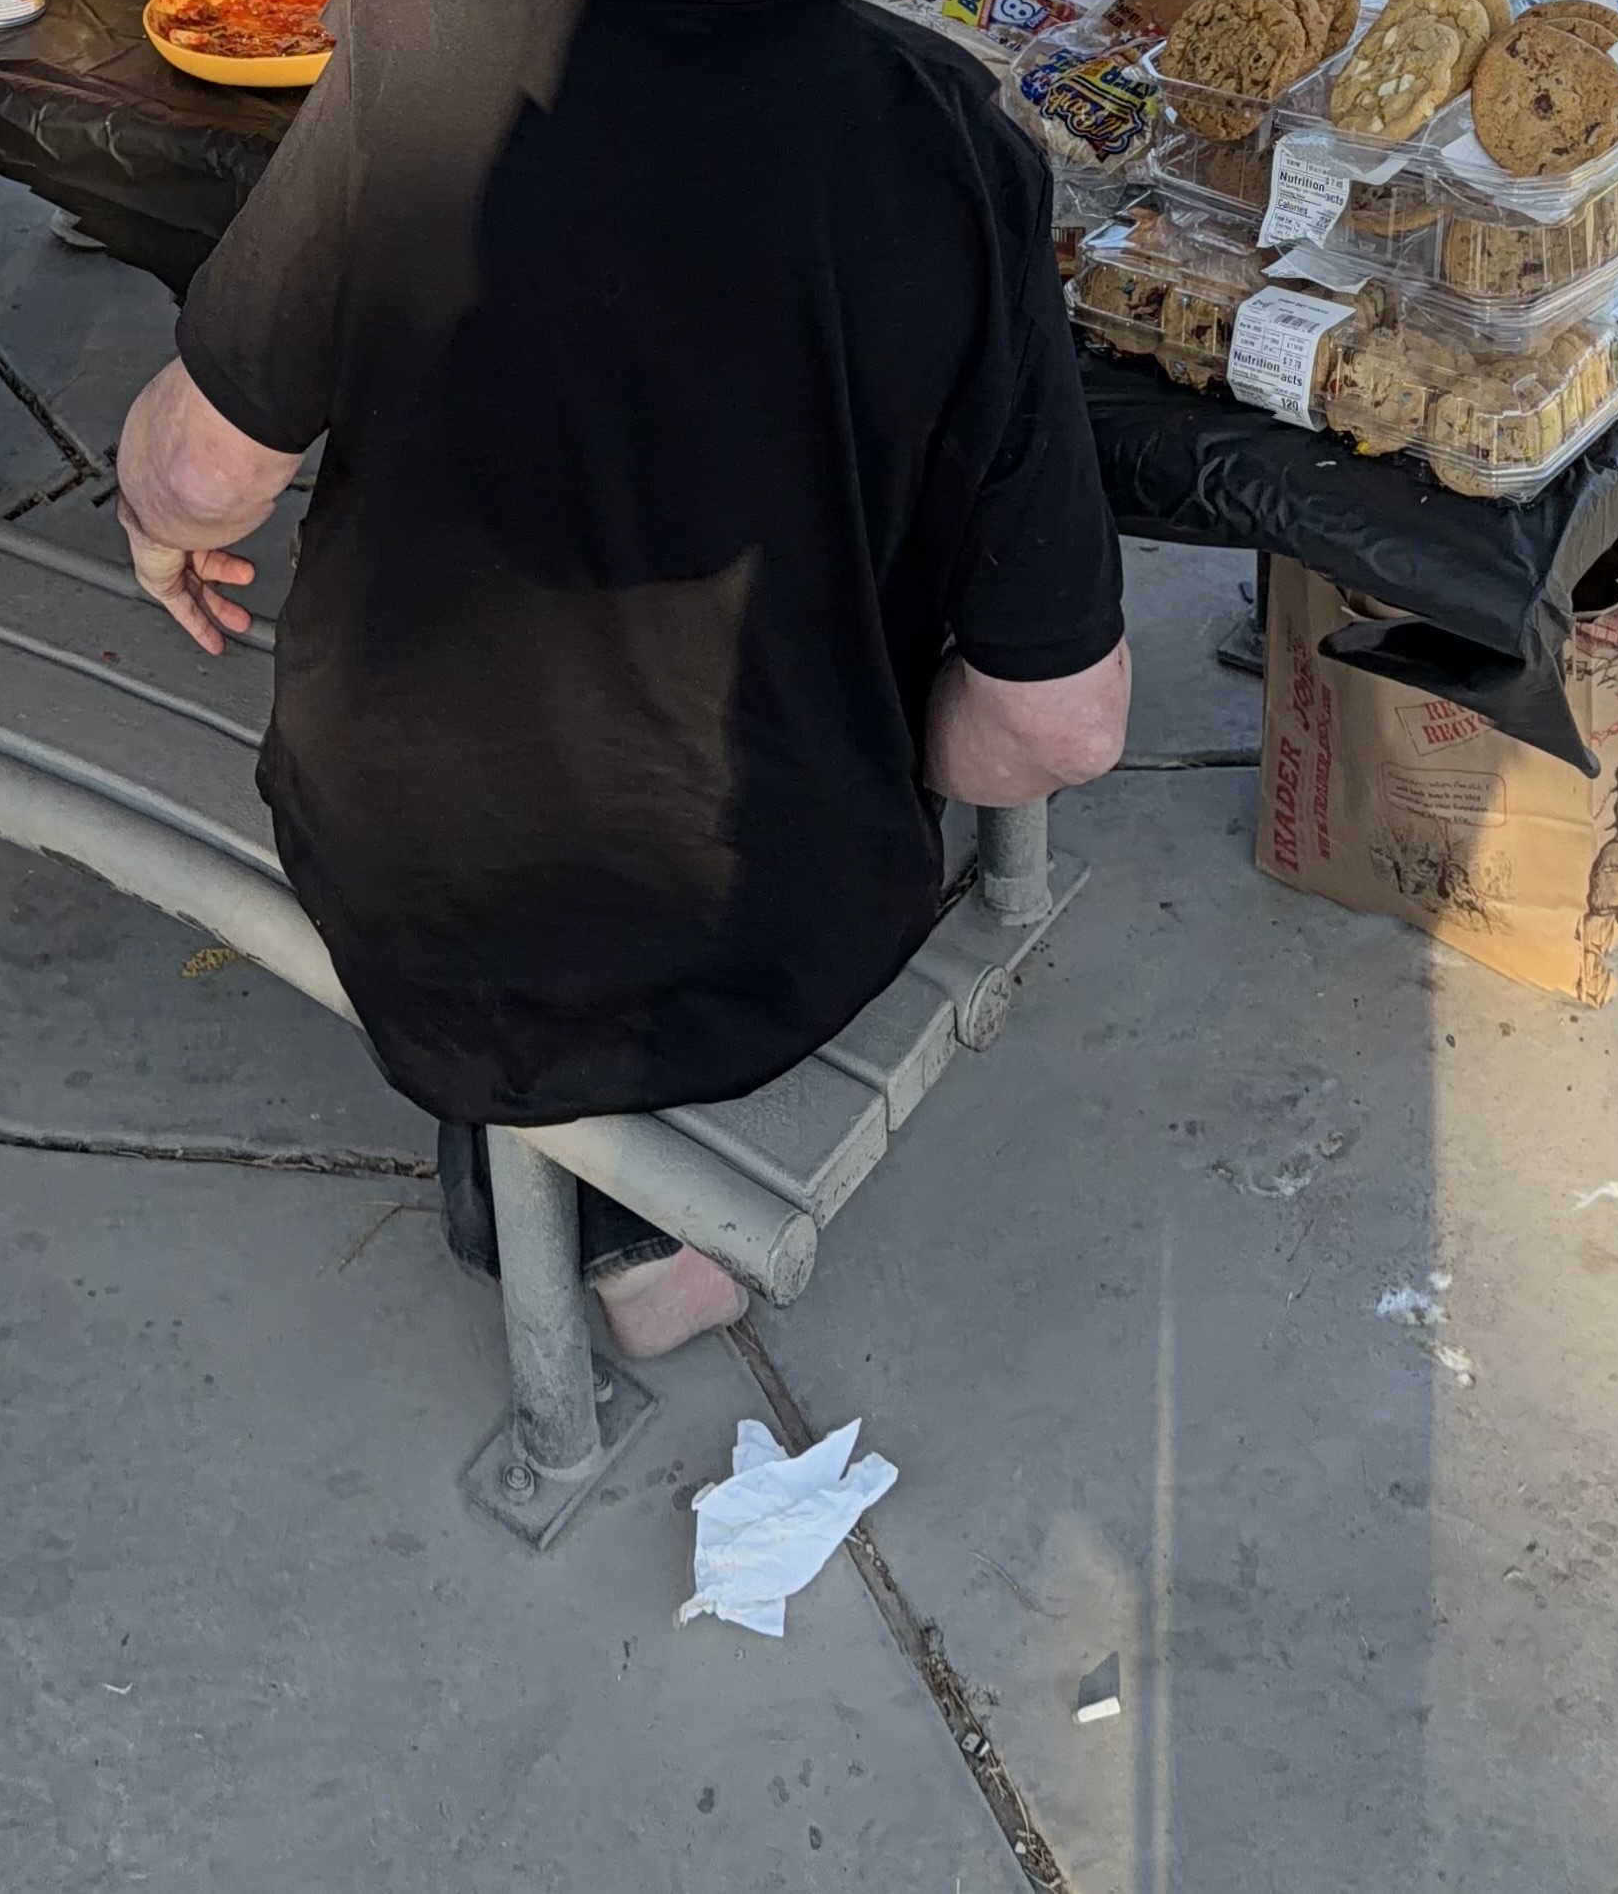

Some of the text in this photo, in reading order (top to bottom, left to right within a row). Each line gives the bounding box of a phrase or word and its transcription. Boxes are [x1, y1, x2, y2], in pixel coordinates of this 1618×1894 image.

[1279, 171, 1325, 193] Nutrition
[1277, 198, 1308, 215] Calories
[1233, 349, 1281, 373] Nutrition
[1273, 735, 1302, 875] TRADER
